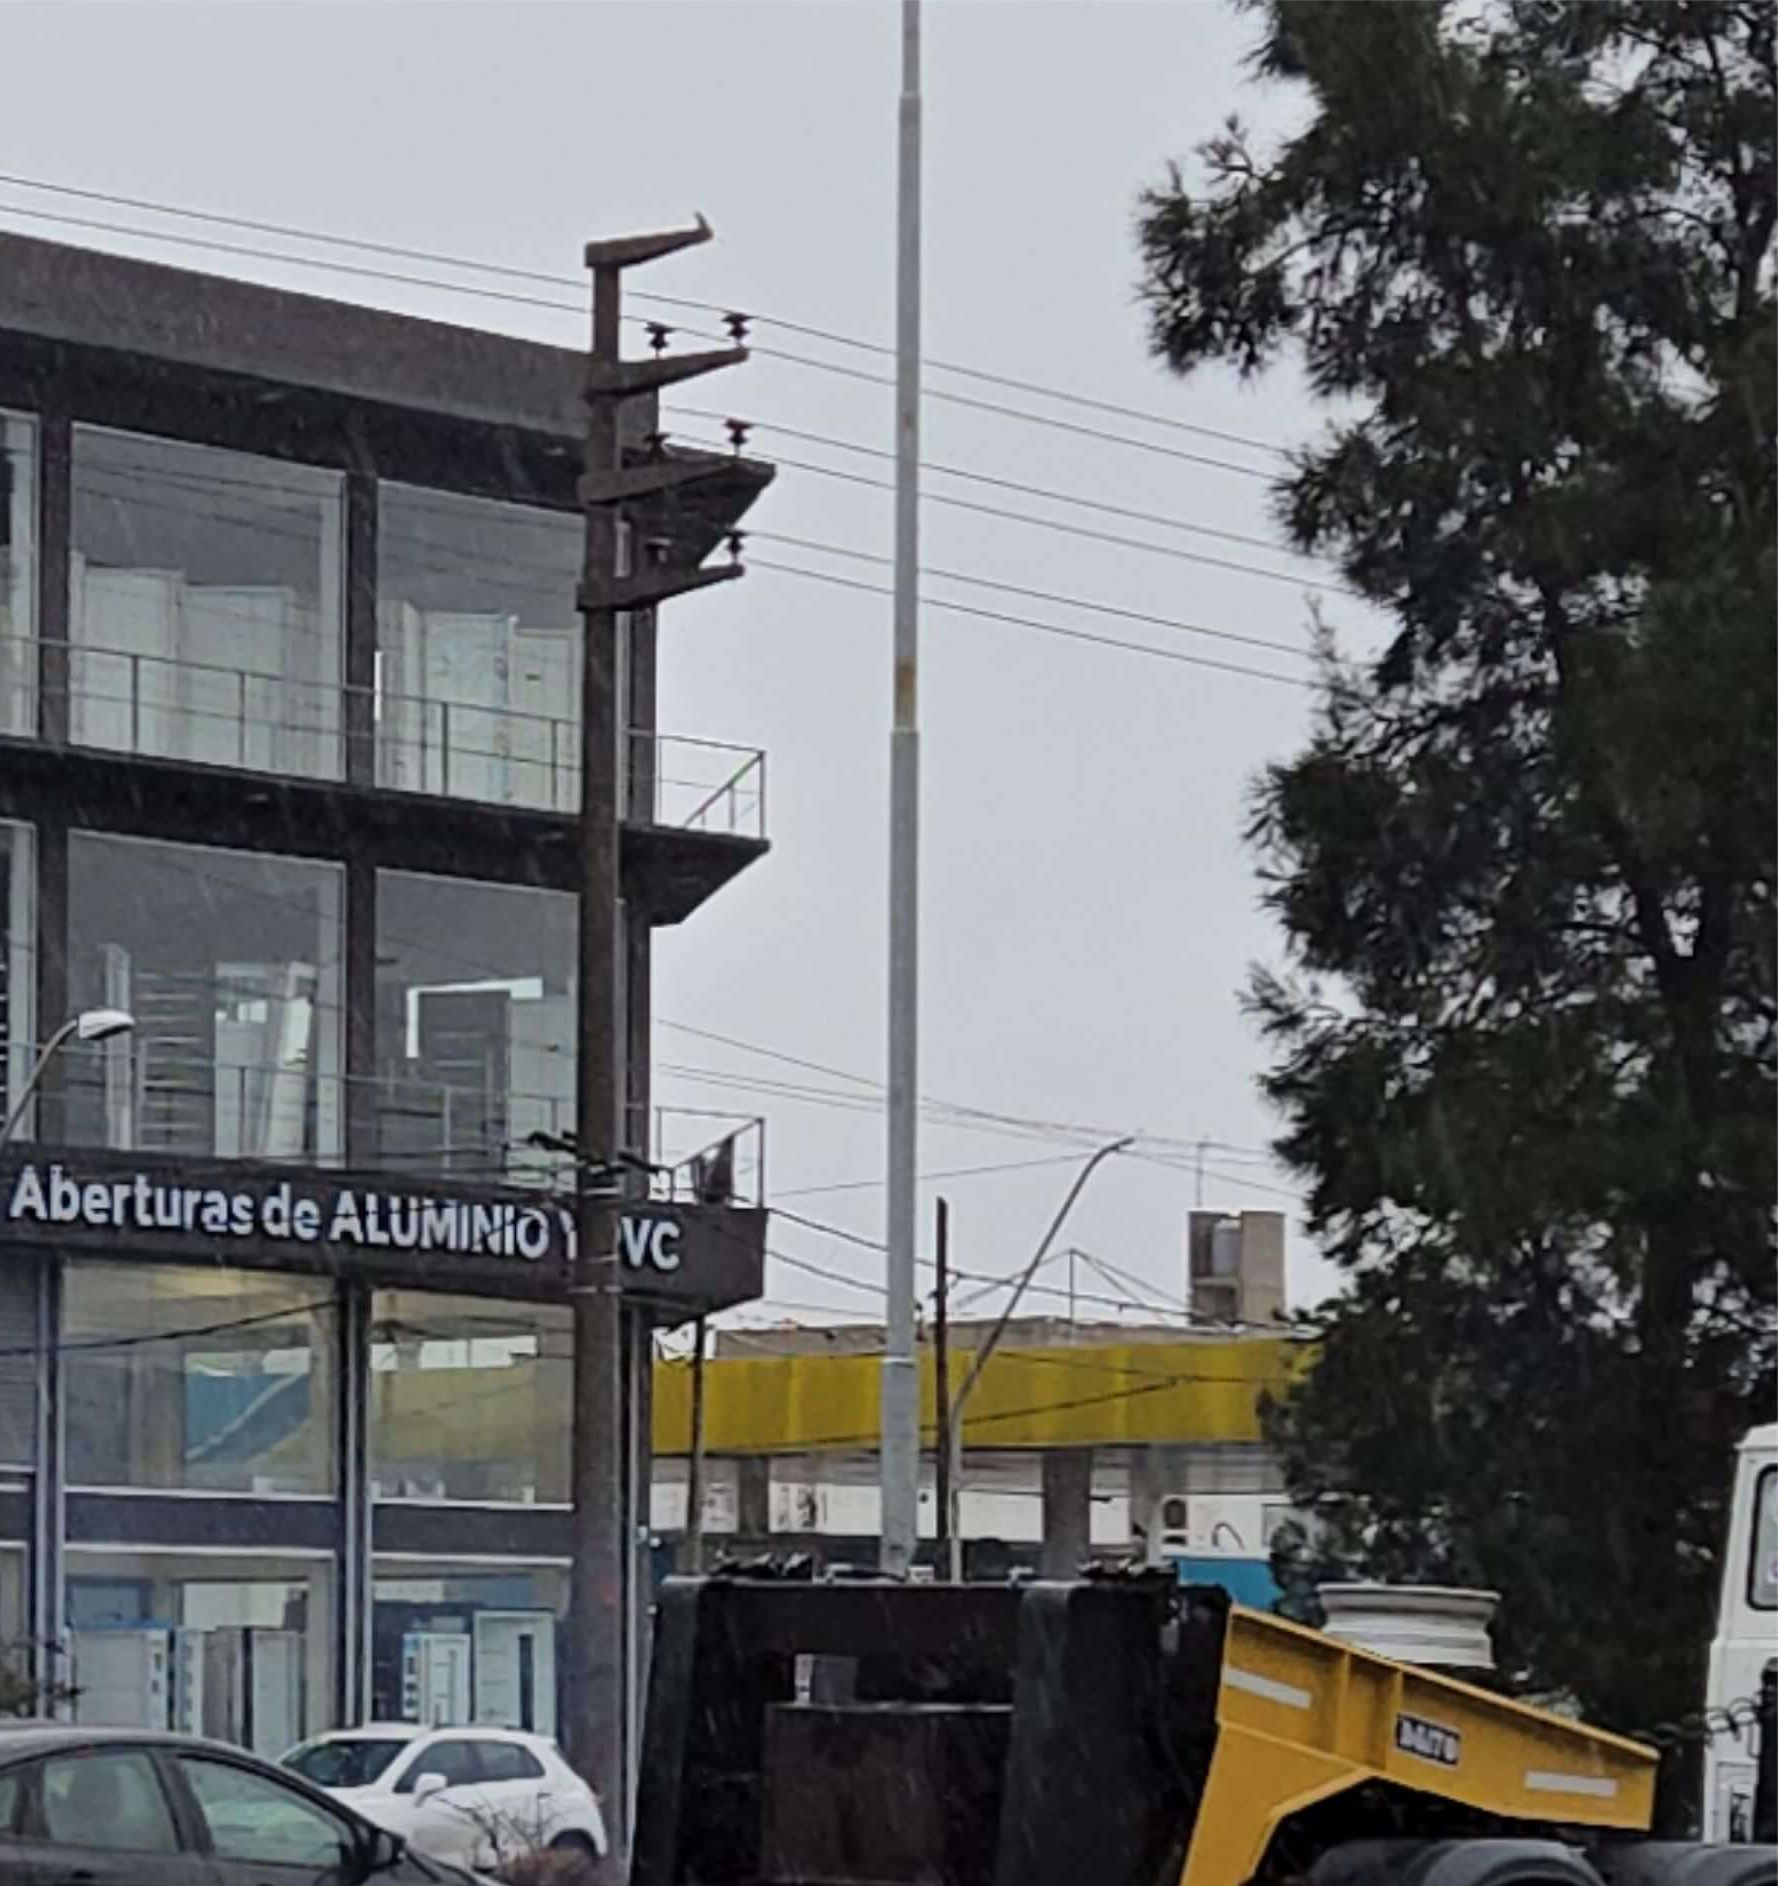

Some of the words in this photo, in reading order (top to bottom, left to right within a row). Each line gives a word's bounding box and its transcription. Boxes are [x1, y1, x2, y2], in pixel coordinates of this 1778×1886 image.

[9, 1163, 255, 1236] Aberturas
[261, 1182, 321, 1241] de
[329, 1189, 551, 1260] ALUMINIO
[617, 1216, 682, 1271] VC
